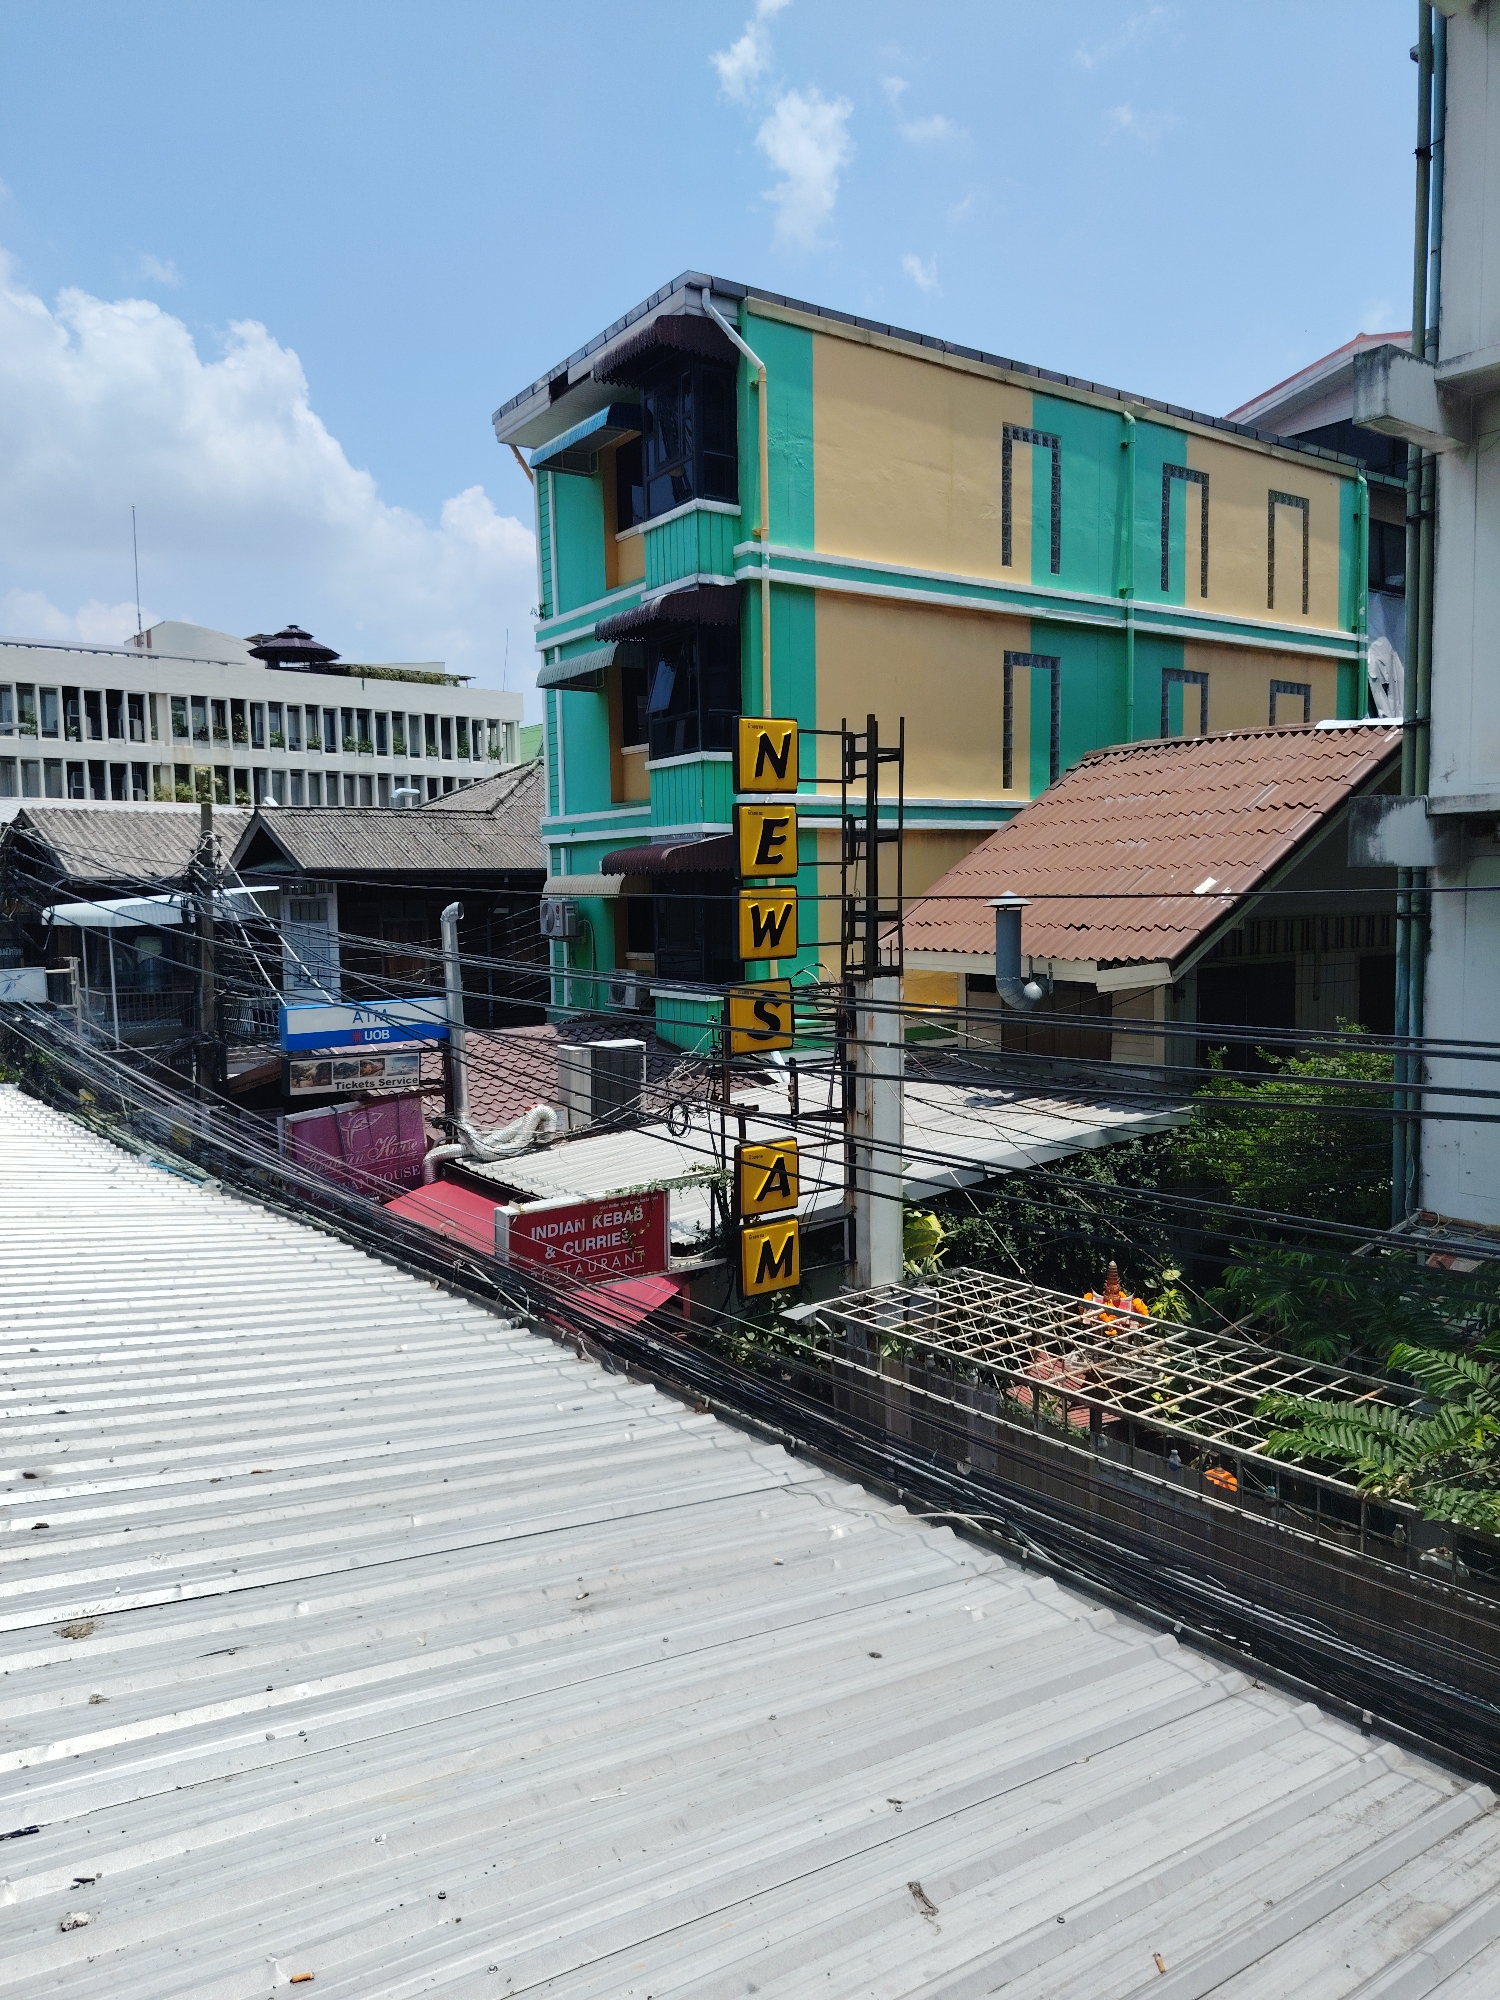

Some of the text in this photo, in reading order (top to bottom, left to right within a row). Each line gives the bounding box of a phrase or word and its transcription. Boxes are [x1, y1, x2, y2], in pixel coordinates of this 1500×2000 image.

[364, 1029, 390, 1041] UOB
[334, 1076, 419, 1091] Tickets Service
[531, 1206, 643, 1240] INDIAN KEBAB
[545, 1228, 630, 1260] & CURRIES
